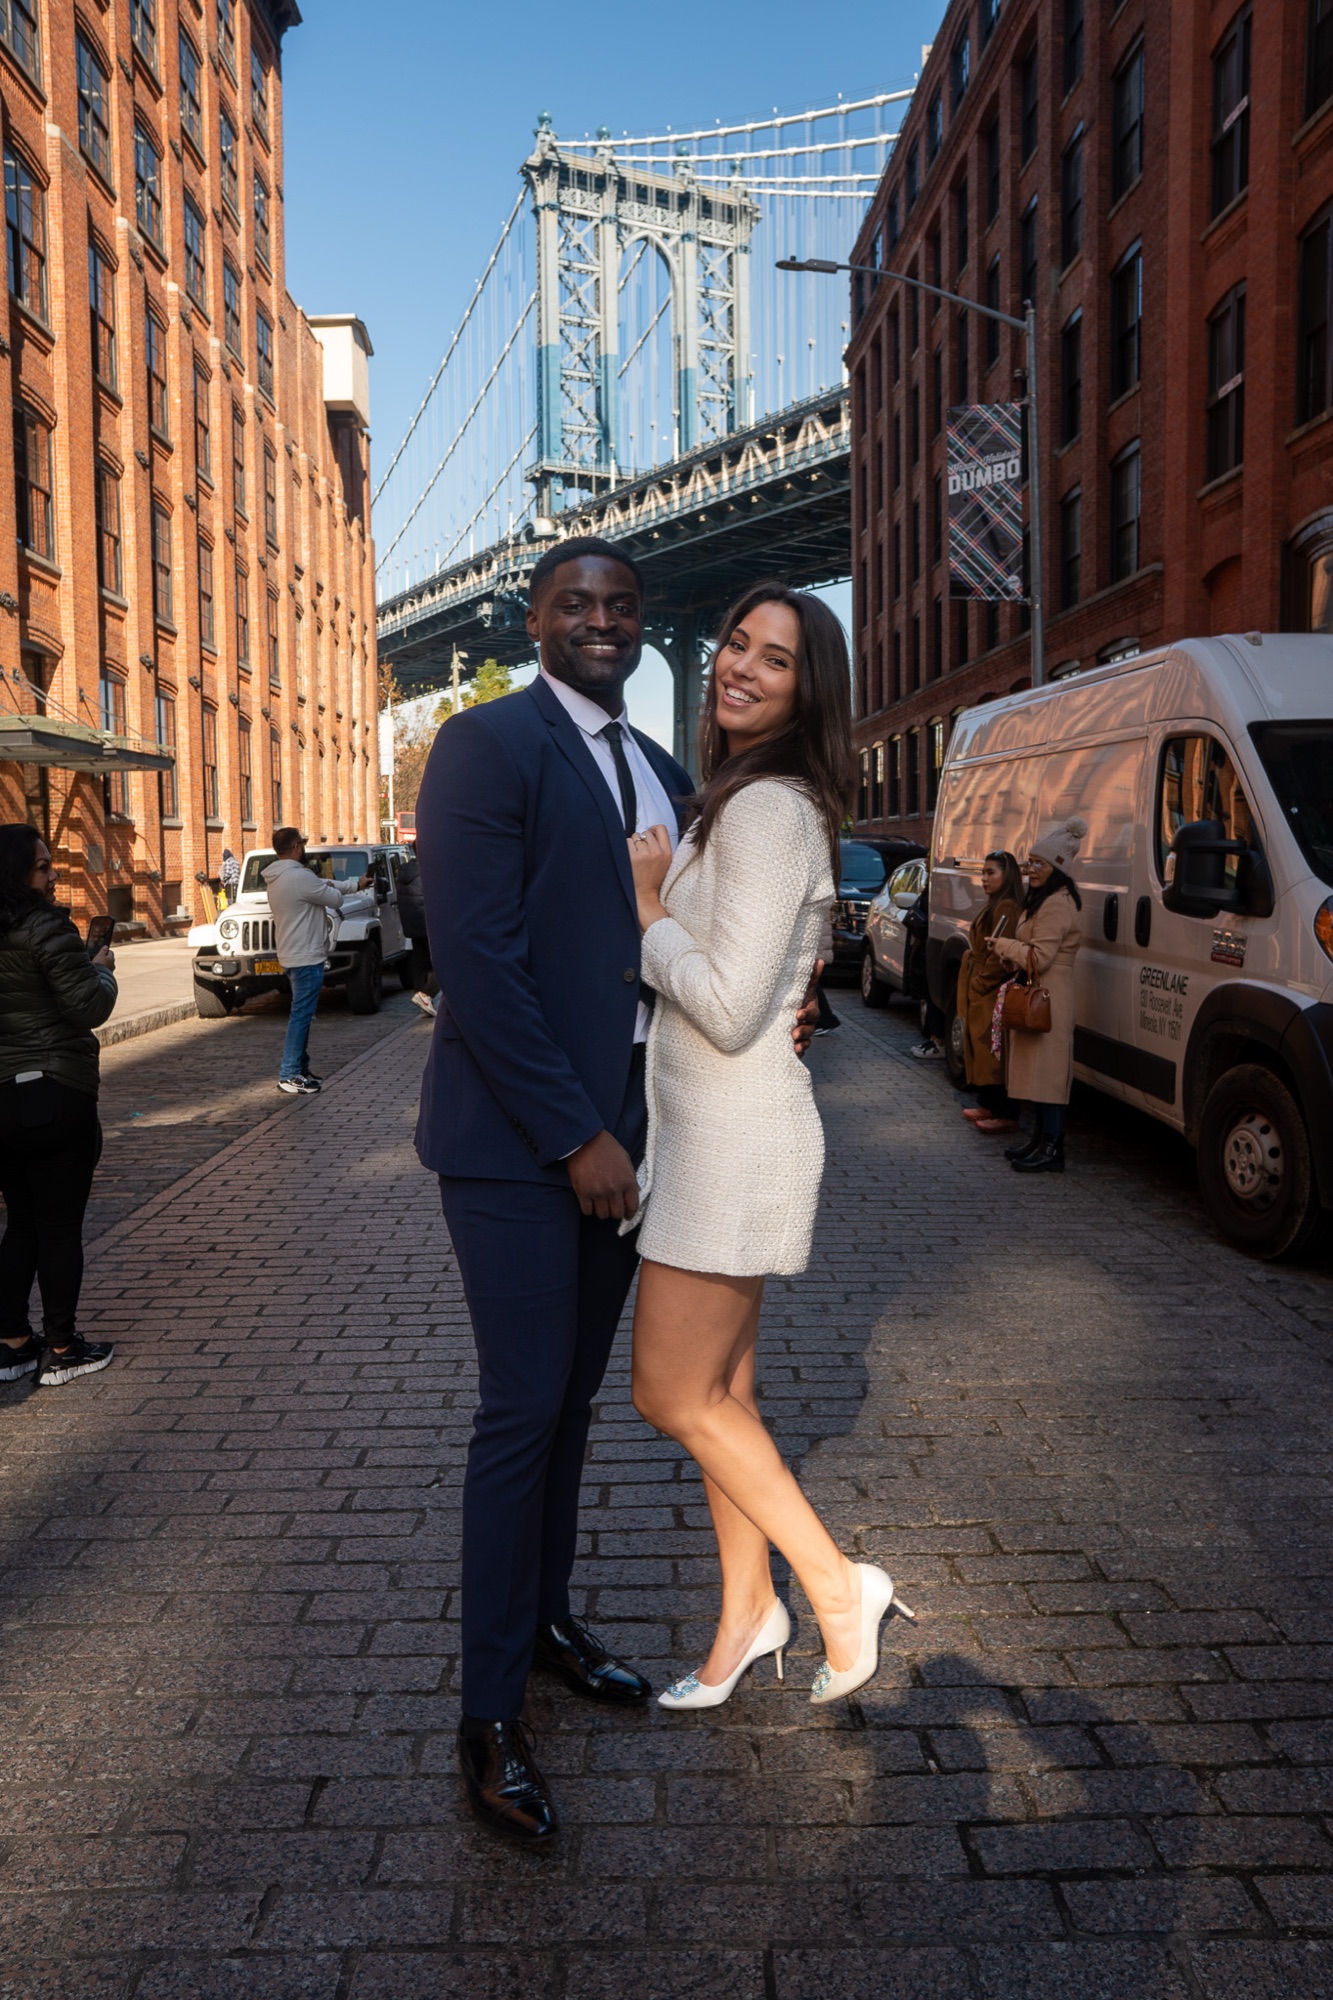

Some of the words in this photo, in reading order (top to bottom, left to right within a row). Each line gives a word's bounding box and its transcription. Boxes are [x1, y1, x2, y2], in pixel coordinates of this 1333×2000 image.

[983, 449, 1022, 463] Holidays
[948, 458, 1021, 496] DUMBO
[1140, 966, 1189, 996] GREENLANE
[1158, 1015, 1167, 1036] NY
